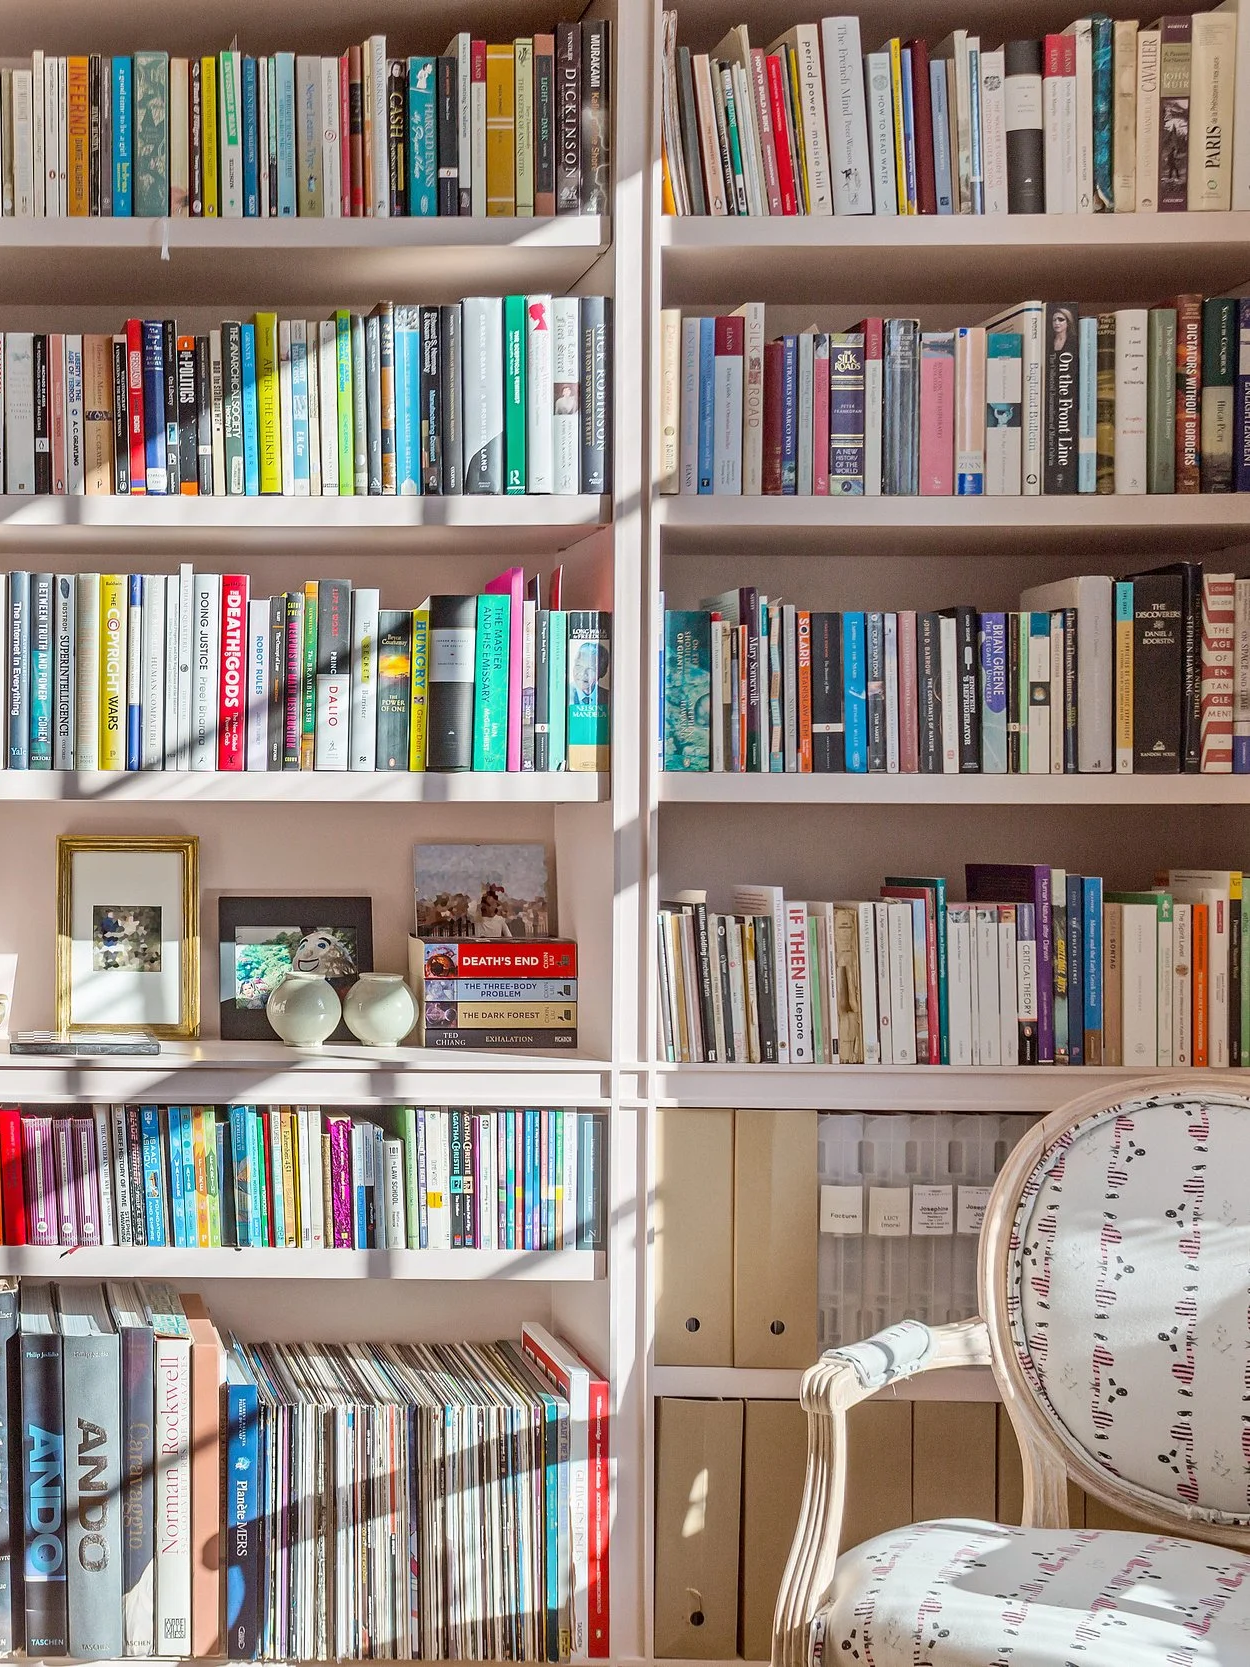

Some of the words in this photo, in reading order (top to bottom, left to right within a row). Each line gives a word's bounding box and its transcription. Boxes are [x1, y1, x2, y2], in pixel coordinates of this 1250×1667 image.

[837, 25, 848, 46] The
[376, 43, 384, 65] TONI
[589, 34, 601, 88] MURAKAMI
[803, 41, 817, 79] period
[838, 48, 851, 86] French
[1141, 40, 1158, 93] CAVALIER
[70, 66, 87, 136] INFERNO
[376, 65, 385, 116] MORRISON
[805, 83, 818, 117] power
[840, 88, 853, 117] Mind
[878, 95, 886, 115] HOW
[390, 92, 404, 139] CASH
[425, 104, 434, 150] HAROLD
[564, 69, 577, 180] DICKINSON
[879, 119, 886, 131] TO
[811, 130, 822, 166] maisie
[879, 134, 887, 154] READ
[1205, 126, 1222, 169] PARIS
[425, 152, 434, 187] EVANS
[815, 171, 825, 188] hill
[880, 157, 889, 185] WATER
[229, 327, 238, 342] THE
[597, 323, 606, 362] NICK
[749, 322, 761, 353] SILK
[1185, 323, 1198, 375] DICTATORS
[68, 366, 75, 376] OF
[131, 351, 141, 388] PERSUASION
[230, 341, 240, 401] ANARCHICAL
[263, 358, 273, 393] AFTER
[834, 361, 861, 373] ROADS
[837, 353, 857, 364] SILK
[1058, 352, 1073, 372] On
[75, 378, 82, 387] IN
[179, 361, 194, 404] POLITICS
[1026, 362, 1040, 408] Baghdad
[1058, 374, 1072, 396] the
[1184, 378, 1197, 419] WITHOUT
[264, 395, 274, 417] THE
[597, 369, 606, 451] ROBINSON
[748, 388, 760, 428] ROAD
[786, 396, 793, 407] OF
[1057, 398, 1073, 435] Front
[231, 401, 241, 439] SOCIETY
[1028, 410, 1039, 452] Bulletin
[265, 419, 275, 467] SHEIKHS
[1057, 437, 1073, 466] Line
[1184, 422, 1197, 466] BORDERS
[13, 601, 22, 620] The
[38, 582, 48, 621] BETWEEN
[199, 592, 210, 628] DOING
[482, 606, 492, 629] AND
[493, 606, 503, 627] THE
[13, 620, 22, 656] Internet
[38, 623, 48, 650] TRUTH
[227, 595, 241, 652] DEATH
[287, 622, 299, 659] WEAPONS
[362, 621, 371, 633] The
[482, 632, 491, 650] HIS
[992, 624, 1004, 654] BRIAN
[1185, 615, 1194, 652] STEPHEN
[1213, 626, 1230, 634] THE
[106, 608, 121, 694] COPYRIGHT
[199, 630, 210, 671] JUSTICE
[255, 635, 264, 666] ROBOT
[415, 620, 427, 690] HUNGRY
[492, 629, 503, 670] MASTER
[747, 636, 759, 660] Mary
[798, 617, 811, 667] SOLARIS
[1211, 640, 1231, 649] AGE
[1215, 654, 1227, 662] OF
[13, 657, 22, 667] in
[38, 652, 48, 669] AND
[149, 656, 158, 691] HUMAN
[287, 661, 299, 671] OF
[362, 643, 370, 680] SECRET
[480, 652, 491, 703] EMISSARY
[992, 657, 1004, 696] GREENE
[1185, 654, 1194, 697] HAWKING
[1214, 668, 1229, 676] EN-
[11, 667, 21, 716] Everything
[38, 672, 48, 701] POWER
[58, 635, 70, 737] SUPERINTELLIGENCE
[198, 677, 207, 704] Preet
[224, 656, 240, 708] GODS
[255, 669, 264, 695] RULES
[286, 673, 298, 693] MATH
[749, 661, 759, 706] Somerville
[801, 670, 809, 718] STANISLAW
[1211, 682, 1231, 690] TAN-
[107, 695, 119, 731] WARS
[328, 686, 339, 728] DALIO
[361, 689, 369, 718] Barrister
[380, 704, 390, 713] OF
[391, 704, 406, 713] ONE
[381, 698, 405, 706] POWER
[1207, 709, 1232, 718] MENT
[1211, 696, 1231, 704] GLE-
[38, 716, 48, 742] COHEN
[149, 693, 158, 748] COMPATIBLE
[198, 705, 208, 746] Bharara
[286, 697, 298, 749] DESTRUCTION
[789, 908, 804, 925] IF
[462, 956, 511, 966] DEATH'S
[514, 956, 539, 966] END
[789, 930, 806, 981] THEN
[1021, 945, 1031, 981] CRITICAL
[480, 990, 521, 998] PROBLEM
[794, 982, 804, 999] Jill
[1022, 983, 1032, 1016] THEORY
[462, 1011, 480, 1019] THE
[481, 1011, 505, 1019] DARK
[507, 1011, 540, 1019] FOREST
[794, 1002, 806, 1040] Lepore
[485, 1035, 533, 1043] EXHALATION
[453, 1110, 461, 1141] AGATHA
[143, 1133, 151, 1169] ASIMOV
[149, 1136, 157, 1165] ISAAC
[451, 1141, 462, 1175] CHRISTIE
[462, 1141, 473, 1175] CHRISTIE
[119, 1178, 126, 1188] OF
[390, 1165, 398, 1180] LAW
[391, 1180, 399, 1206] SCHOOL
[160, 1357, 180, 1456] Rockwell
[28, 1423, 63, 1573] ANDO
[77, 1416, 110, 1573] ANDO
[123, 1423, 150, 1549] Caravaggio
[236, 1480, 248, 1520] Planète
[161, 1468, 180, 1554] Norman
[236, 1521, 248, 1556] MERS
[31, 1638, 64, 1646] TASCHEN
